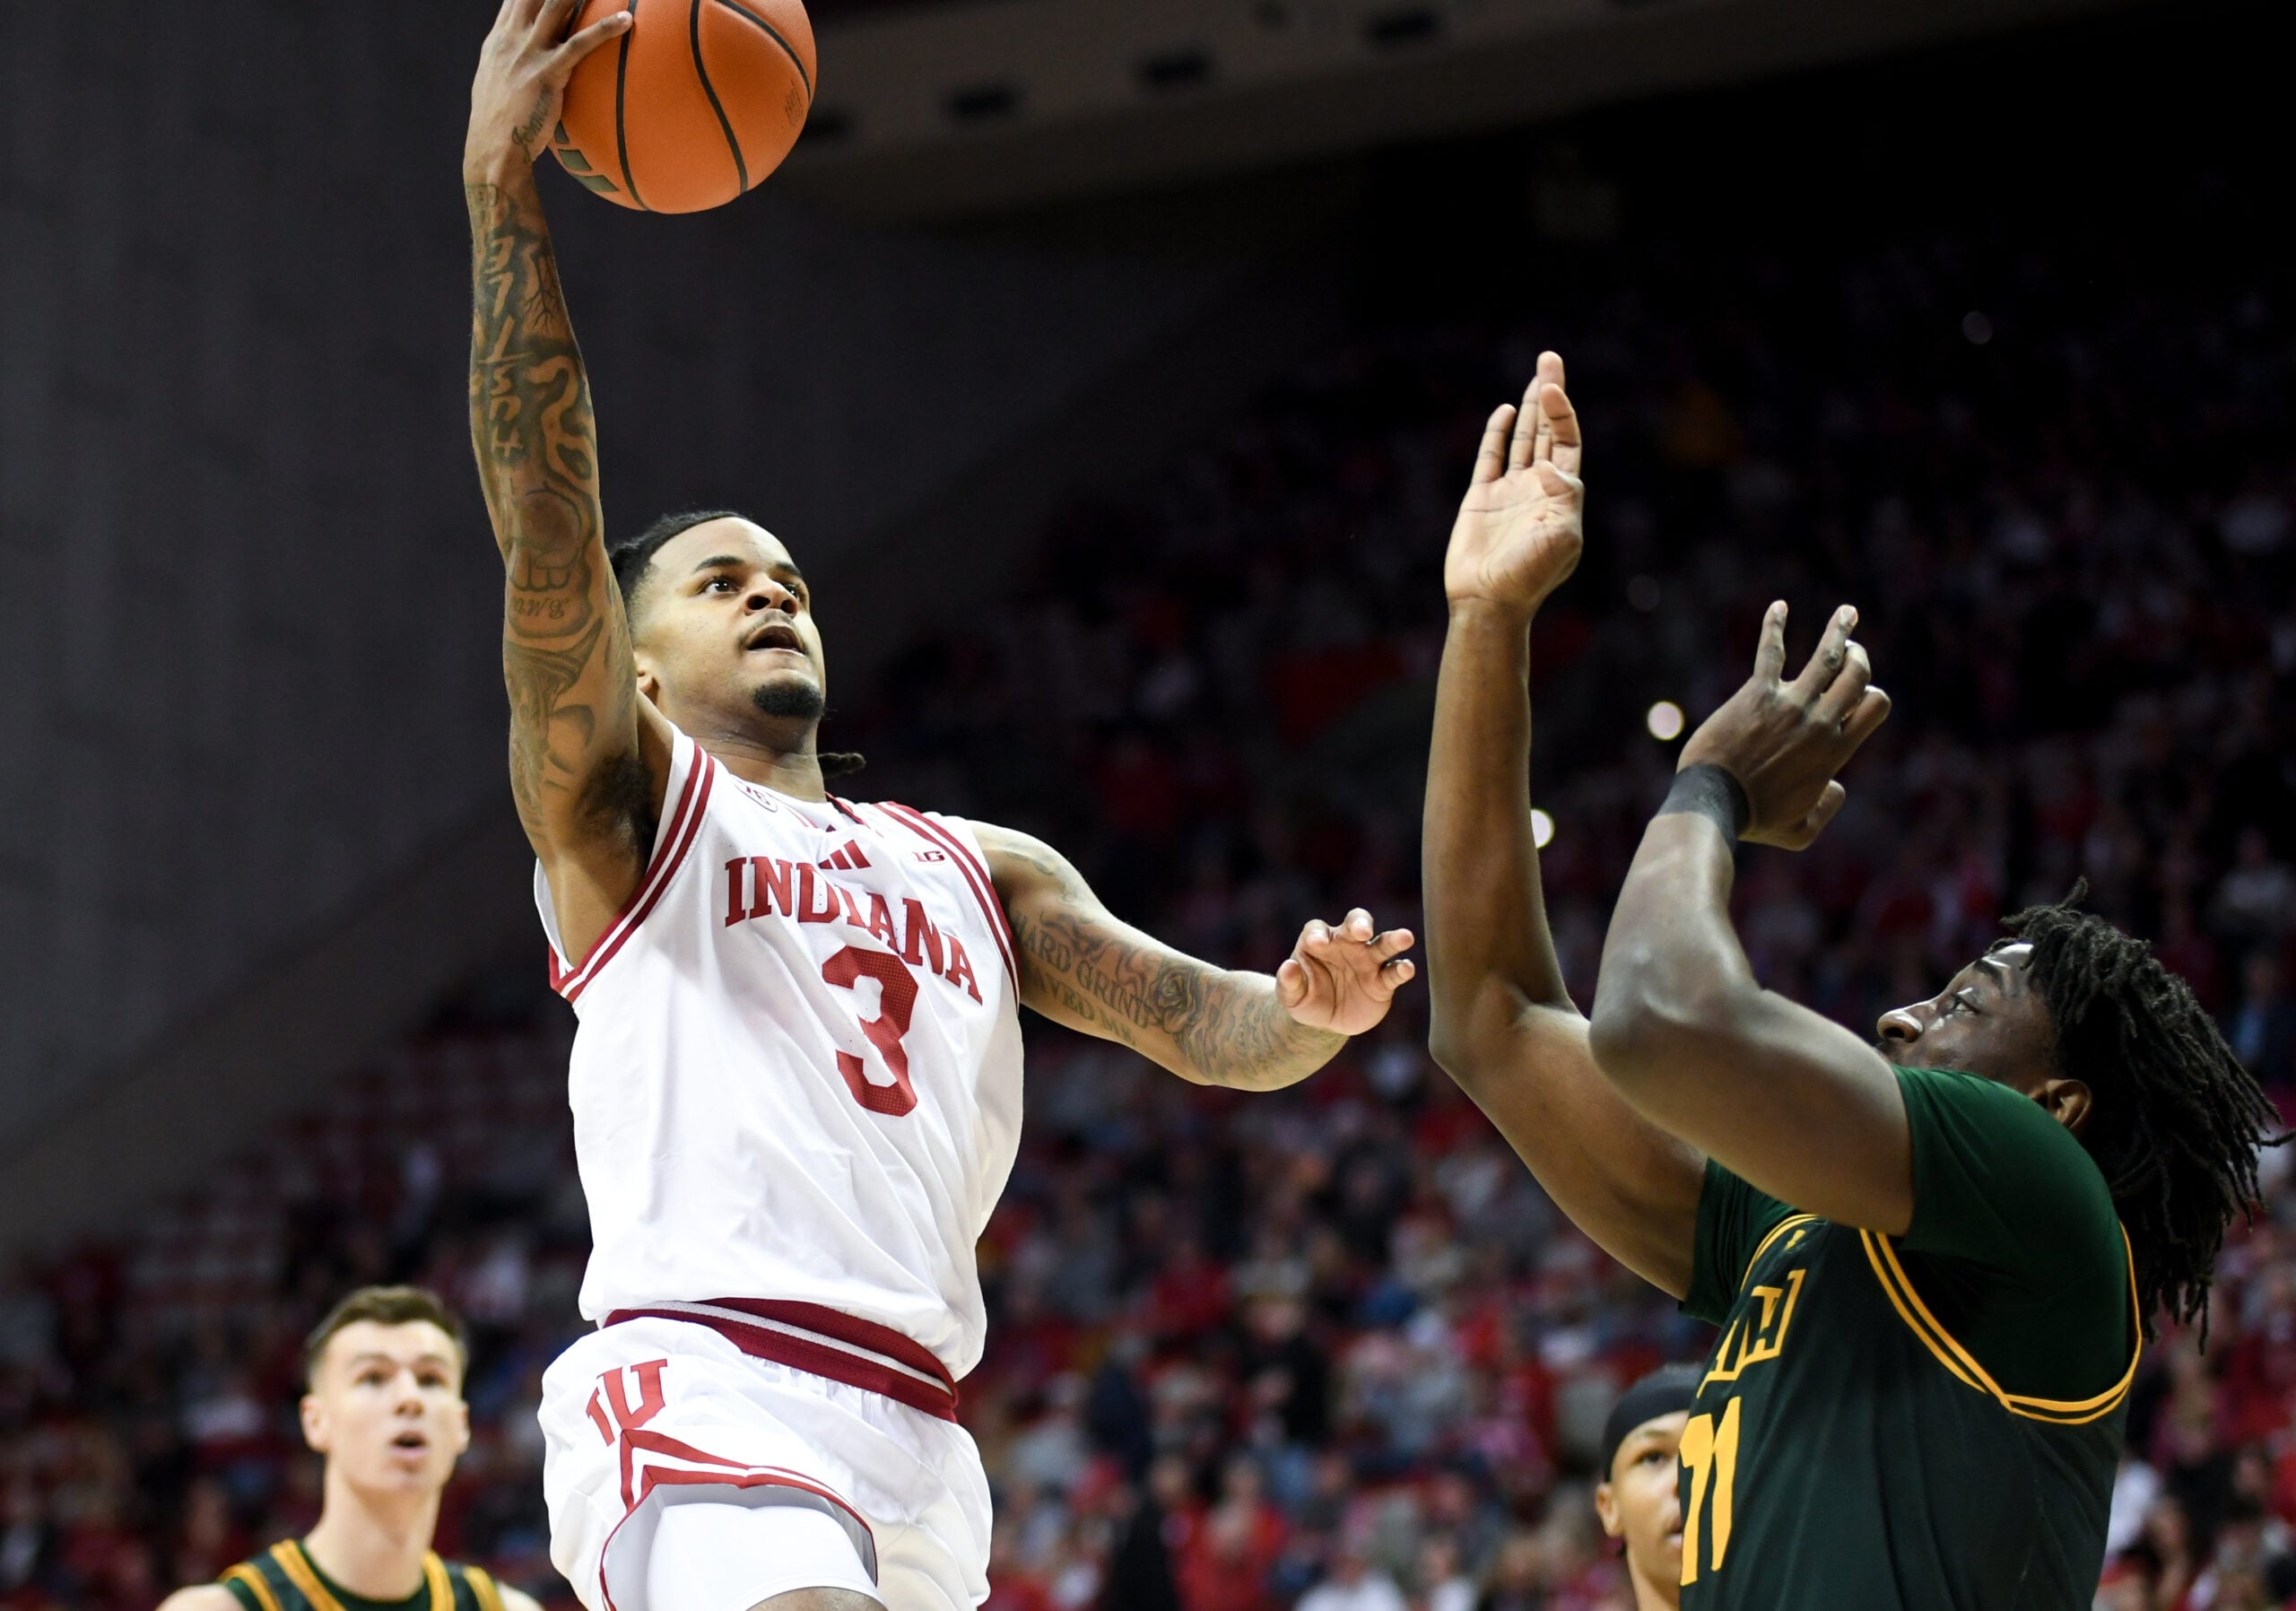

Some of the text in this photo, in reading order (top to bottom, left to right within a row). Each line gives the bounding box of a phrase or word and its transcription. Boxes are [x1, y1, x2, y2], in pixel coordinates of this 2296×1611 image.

[725, 856, 983, 1006] INDIANA
[1076, 960, 1149, 1029] GRIND
[822, 945, 919, 1118] 3
[1678, 1396, 1742, 1587] 11
